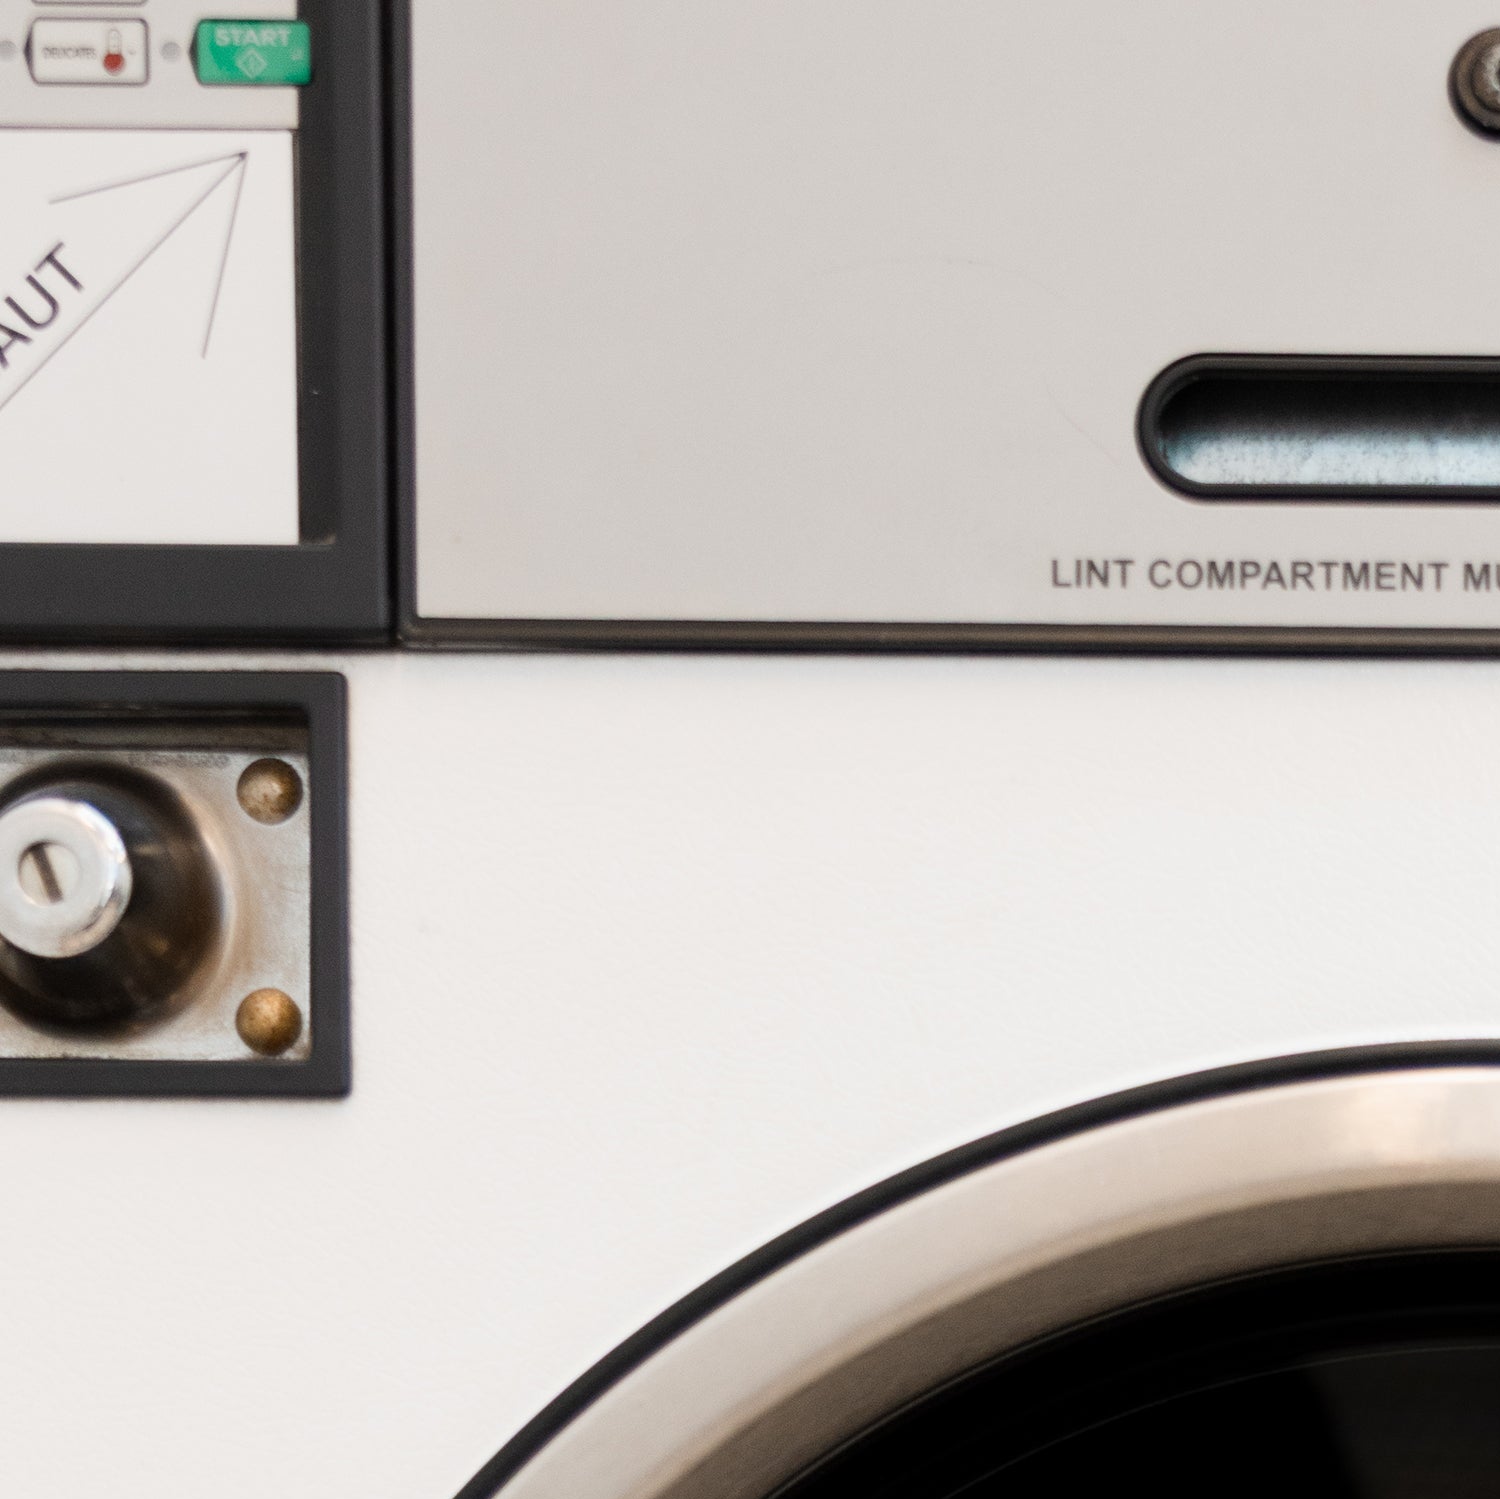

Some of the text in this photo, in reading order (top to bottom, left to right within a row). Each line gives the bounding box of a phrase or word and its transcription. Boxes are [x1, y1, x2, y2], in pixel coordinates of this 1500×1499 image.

[214, 26, 290, 47] START
[1051, 558, 1135, 589] LINT
[1147, 558, 1450, 592] COMPARTMENT
